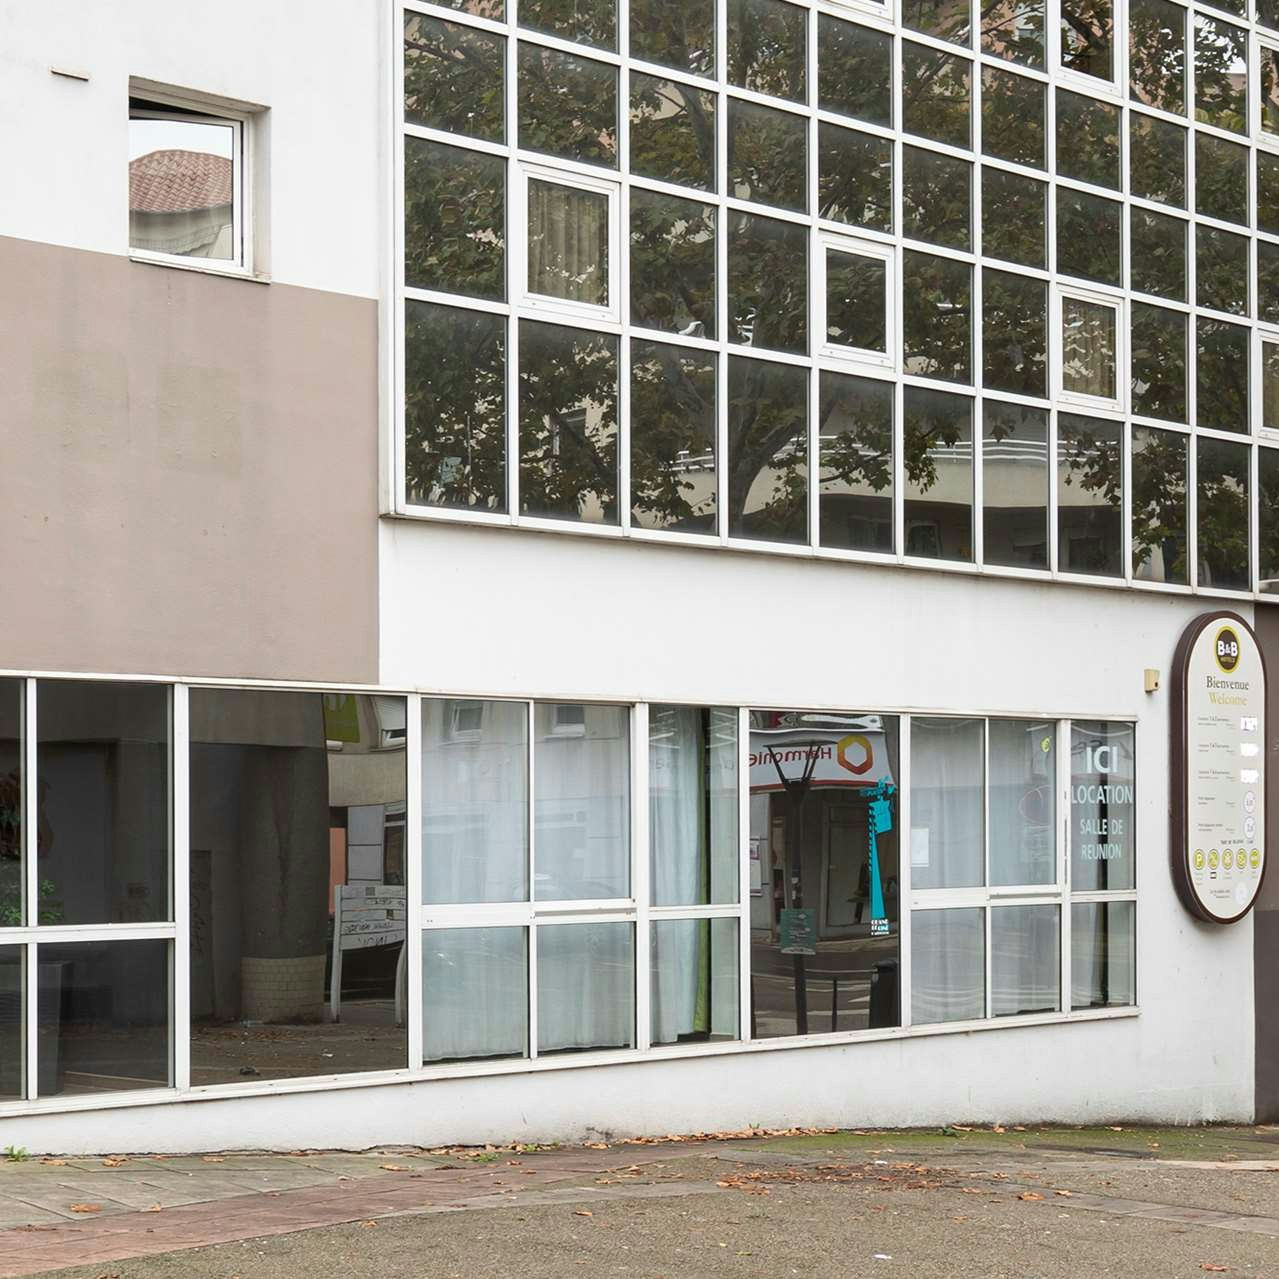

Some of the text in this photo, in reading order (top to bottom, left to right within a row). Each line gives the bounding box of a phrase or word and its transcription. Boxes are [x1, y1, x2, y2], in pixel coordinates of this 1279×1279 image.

[1218, 641, 1238, 657] B&B
[1206, 675, 1249, 690] Bienvenue
[1209, 692, 1247, 706] Welcome
[1086, 745, 1119, 774] ICI
[1071, 785, 1134, 805] LOCATION
[1080, 818, 1123, 835] SALLE DE
